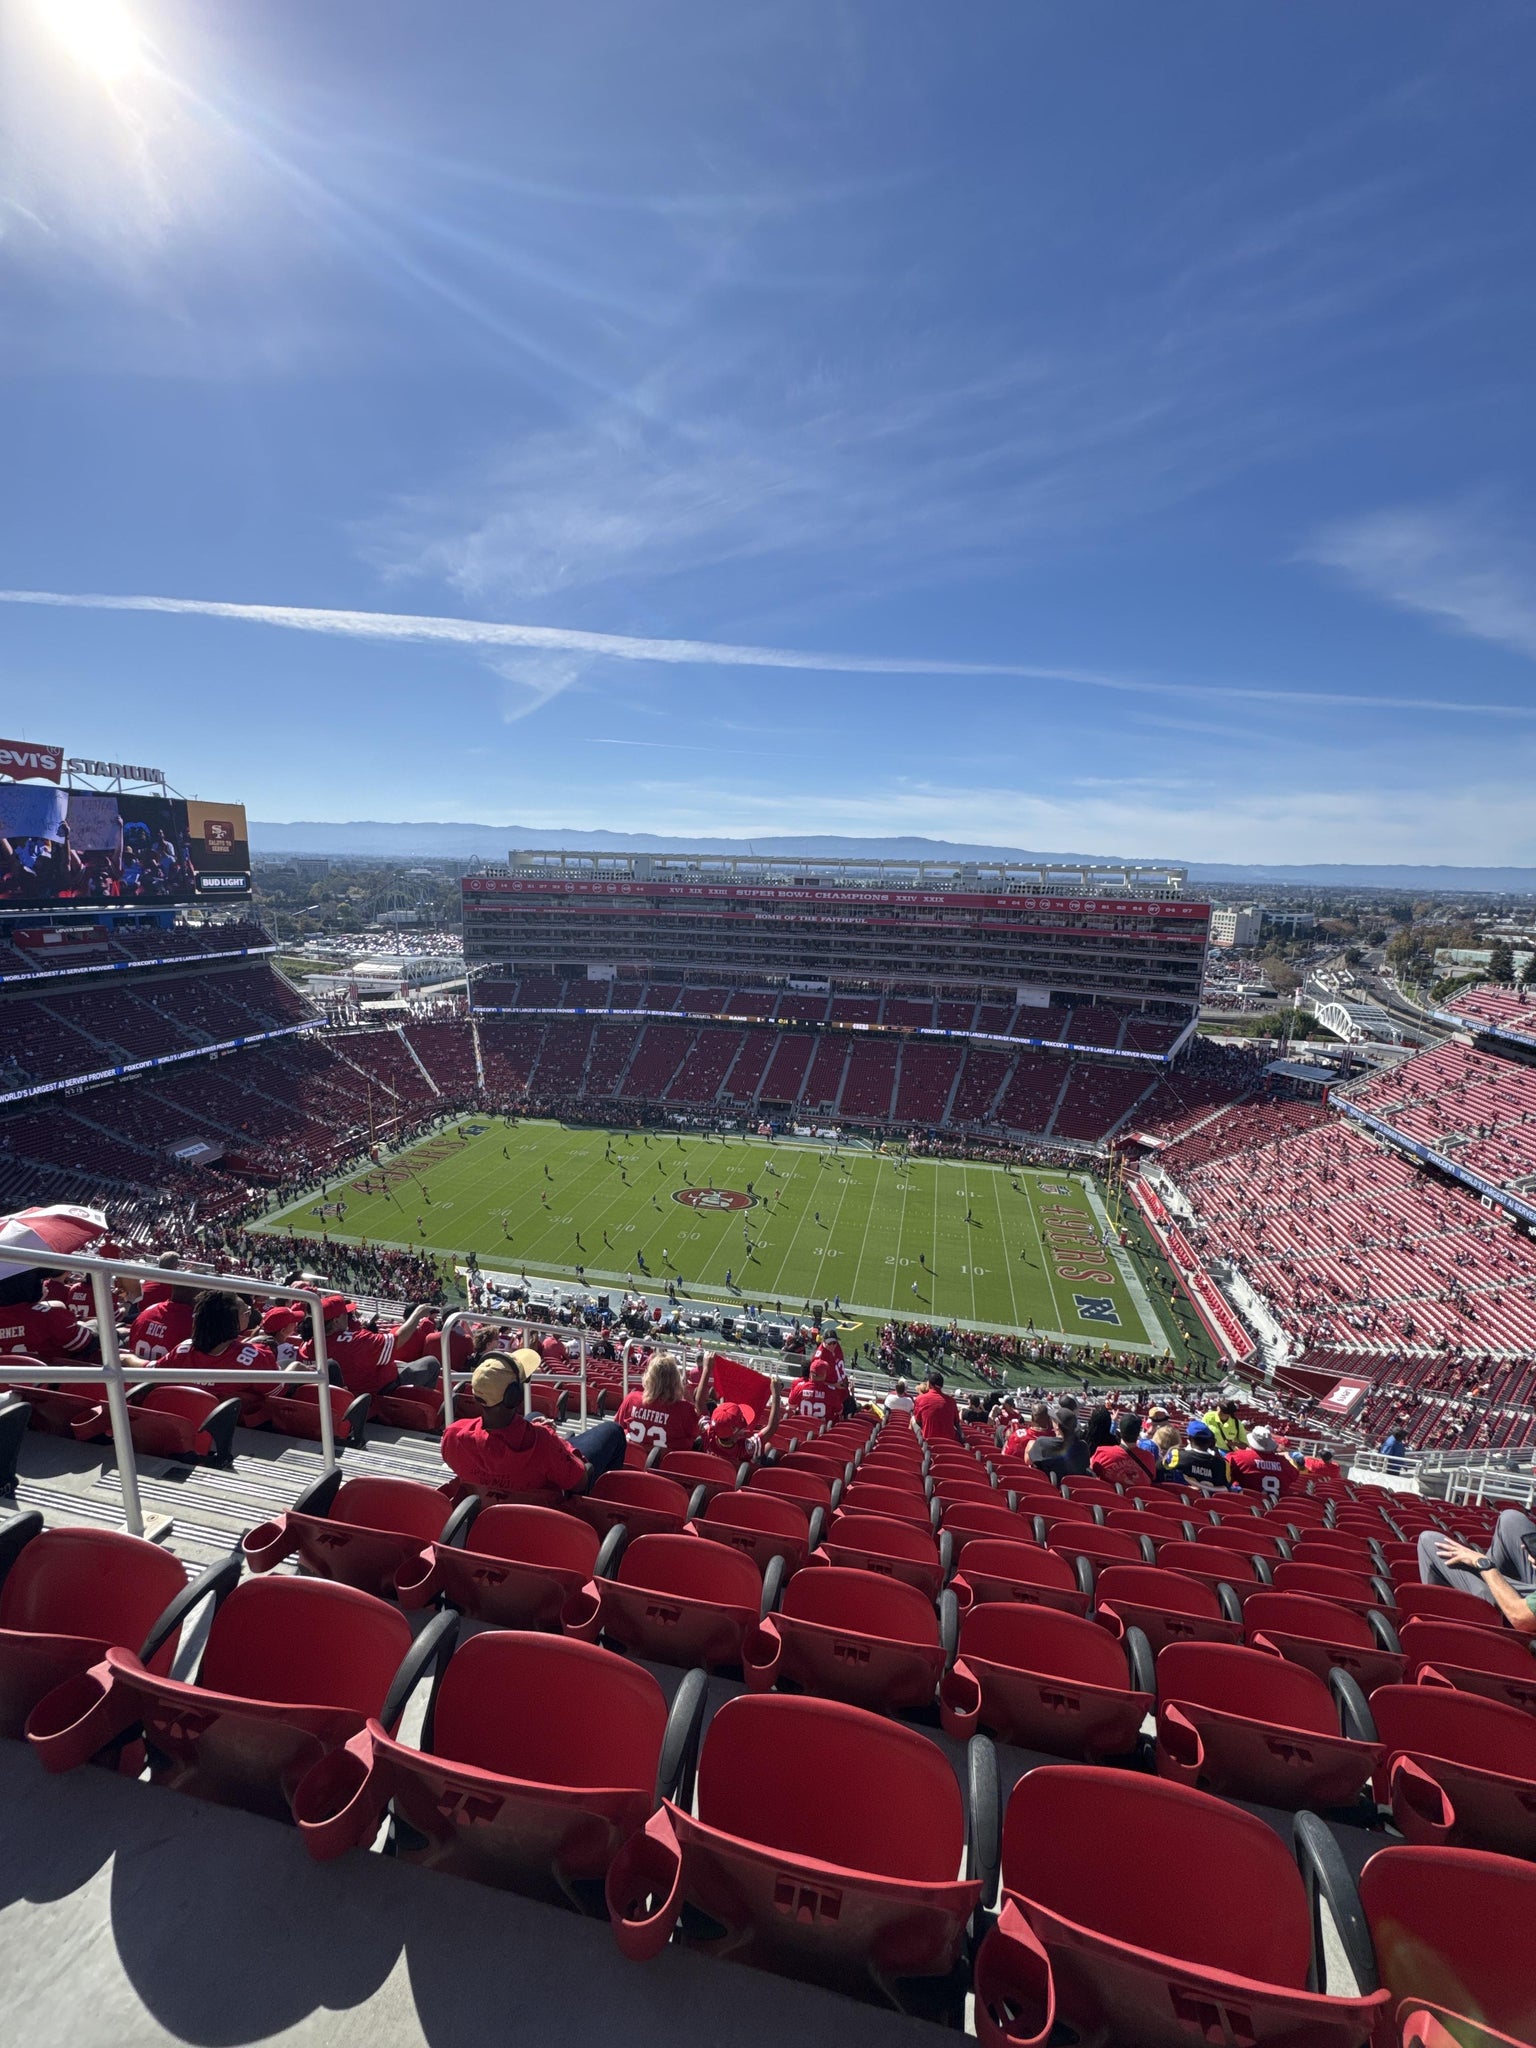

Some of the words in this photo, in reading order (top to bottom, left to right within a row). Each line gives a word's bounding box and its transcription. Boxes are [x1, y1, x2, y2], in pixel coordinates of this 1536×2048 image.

[0, 749, 56, 770] evi's
[69, 758, 161, 782] STADIUM
[815, 892, 889, 900] CHAMPIONS
[177, 1050, 196, 1060] LARGEST
[0, 1089, 28, 1103] WORLD'S
[28, 1082, 57, 1096] LARGEST
[65, 1074, 88, 1087] SERVER
[89, 1068, 116, 1081] PROVIDER
[119, 1073, 142, 1082] verizon
[1460, 1172, 1482, 1188] WORLD'S
[1482, 1184, 1507, 1204] LARGEST
[1507, 1200, 1514, 1208] AI
[813, 1247, 837, 1257] 30
[1039, 1204, 1115, 1285] 49ERS
[885, 1256, 909, 1266] 20
[960, 1265, 985, 1276] 10
[0, 1326, 25, 1339] RNER
[146, 1322, 167, 1338] RICE
[237, 1347, 259, 1366] 80
[631, 1406, 669, 1425] McCAFFREY
[629, 1421, 668, 1448] 23
[1192, 1465, 1212, 1478] NACUA
[1254, 1459, 1282, 1471] YOUNG
[1262, 1476, 1280, 1495] 8
